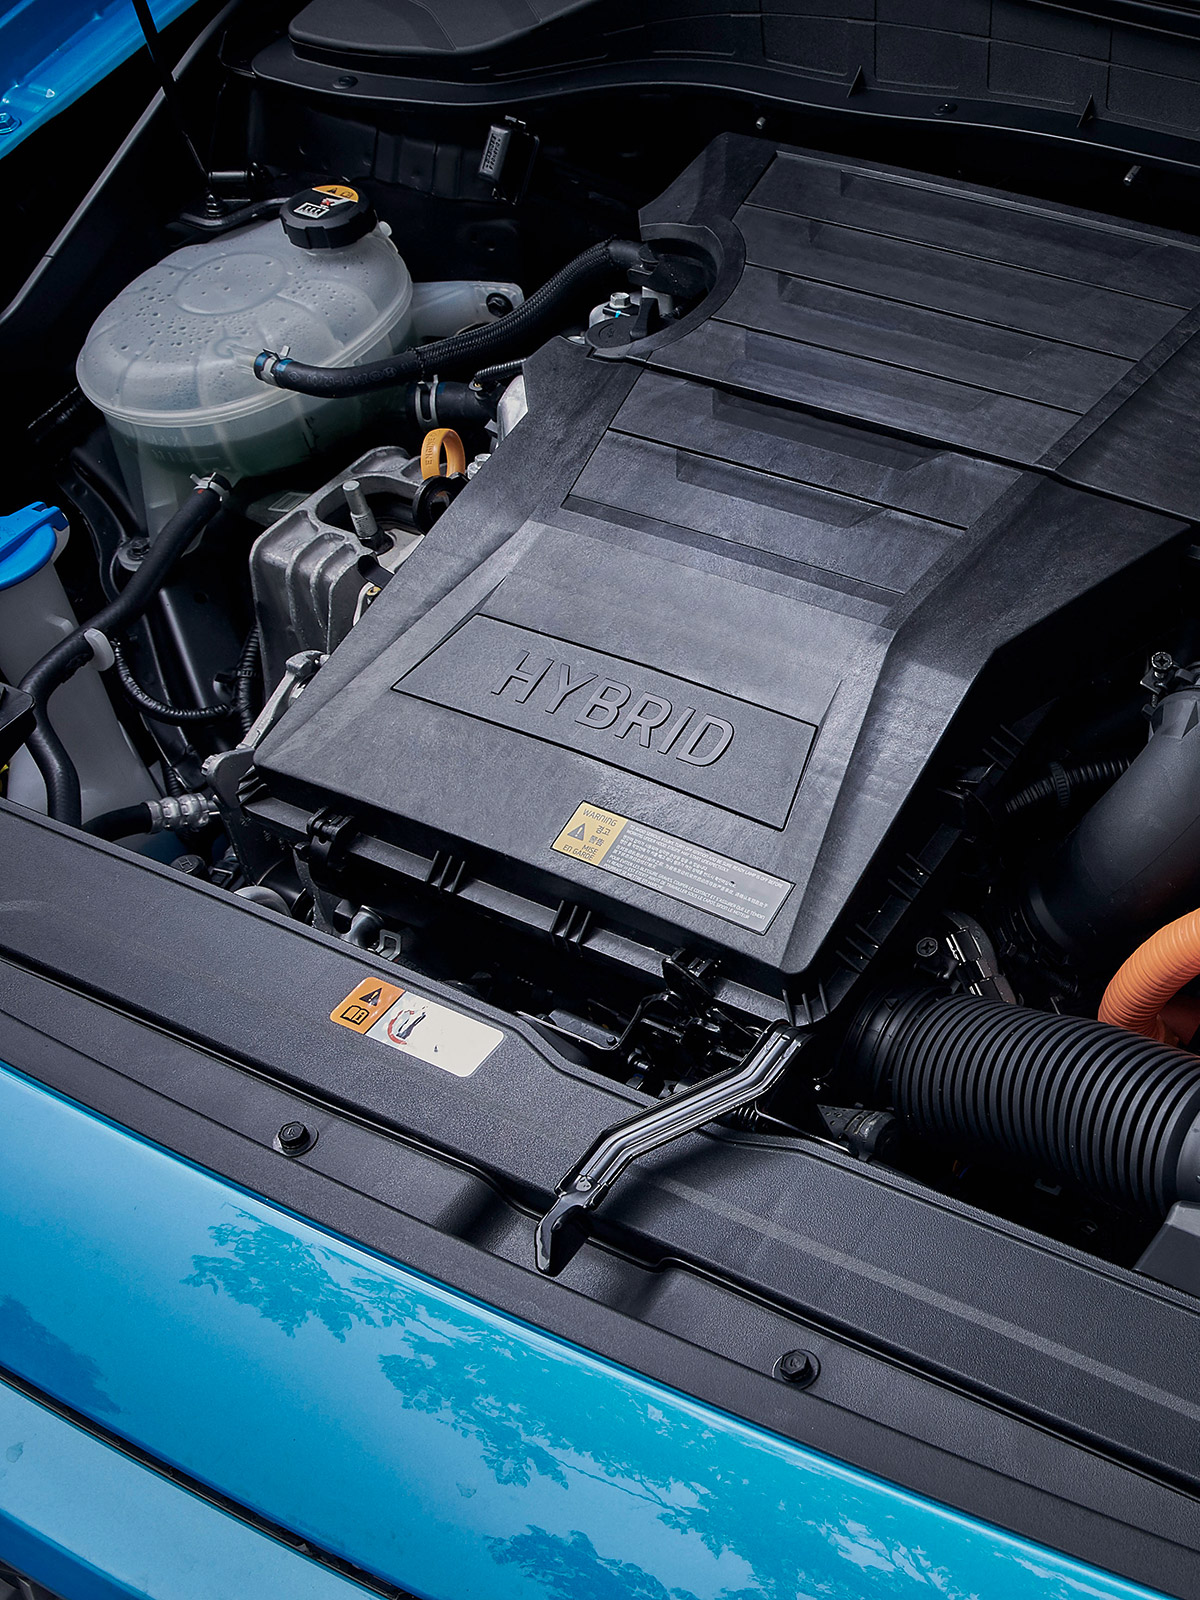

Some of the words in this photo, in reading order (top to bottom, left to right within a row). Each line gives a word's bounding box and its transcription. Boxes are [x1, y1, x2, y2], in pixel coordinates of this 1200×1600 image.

[490, 649, 736, 768] HYBRID
[582, 808, 619, 828] WARNING
[572, 847, 595, 861] GARDE
[581, 844, 599, 855] MISE
